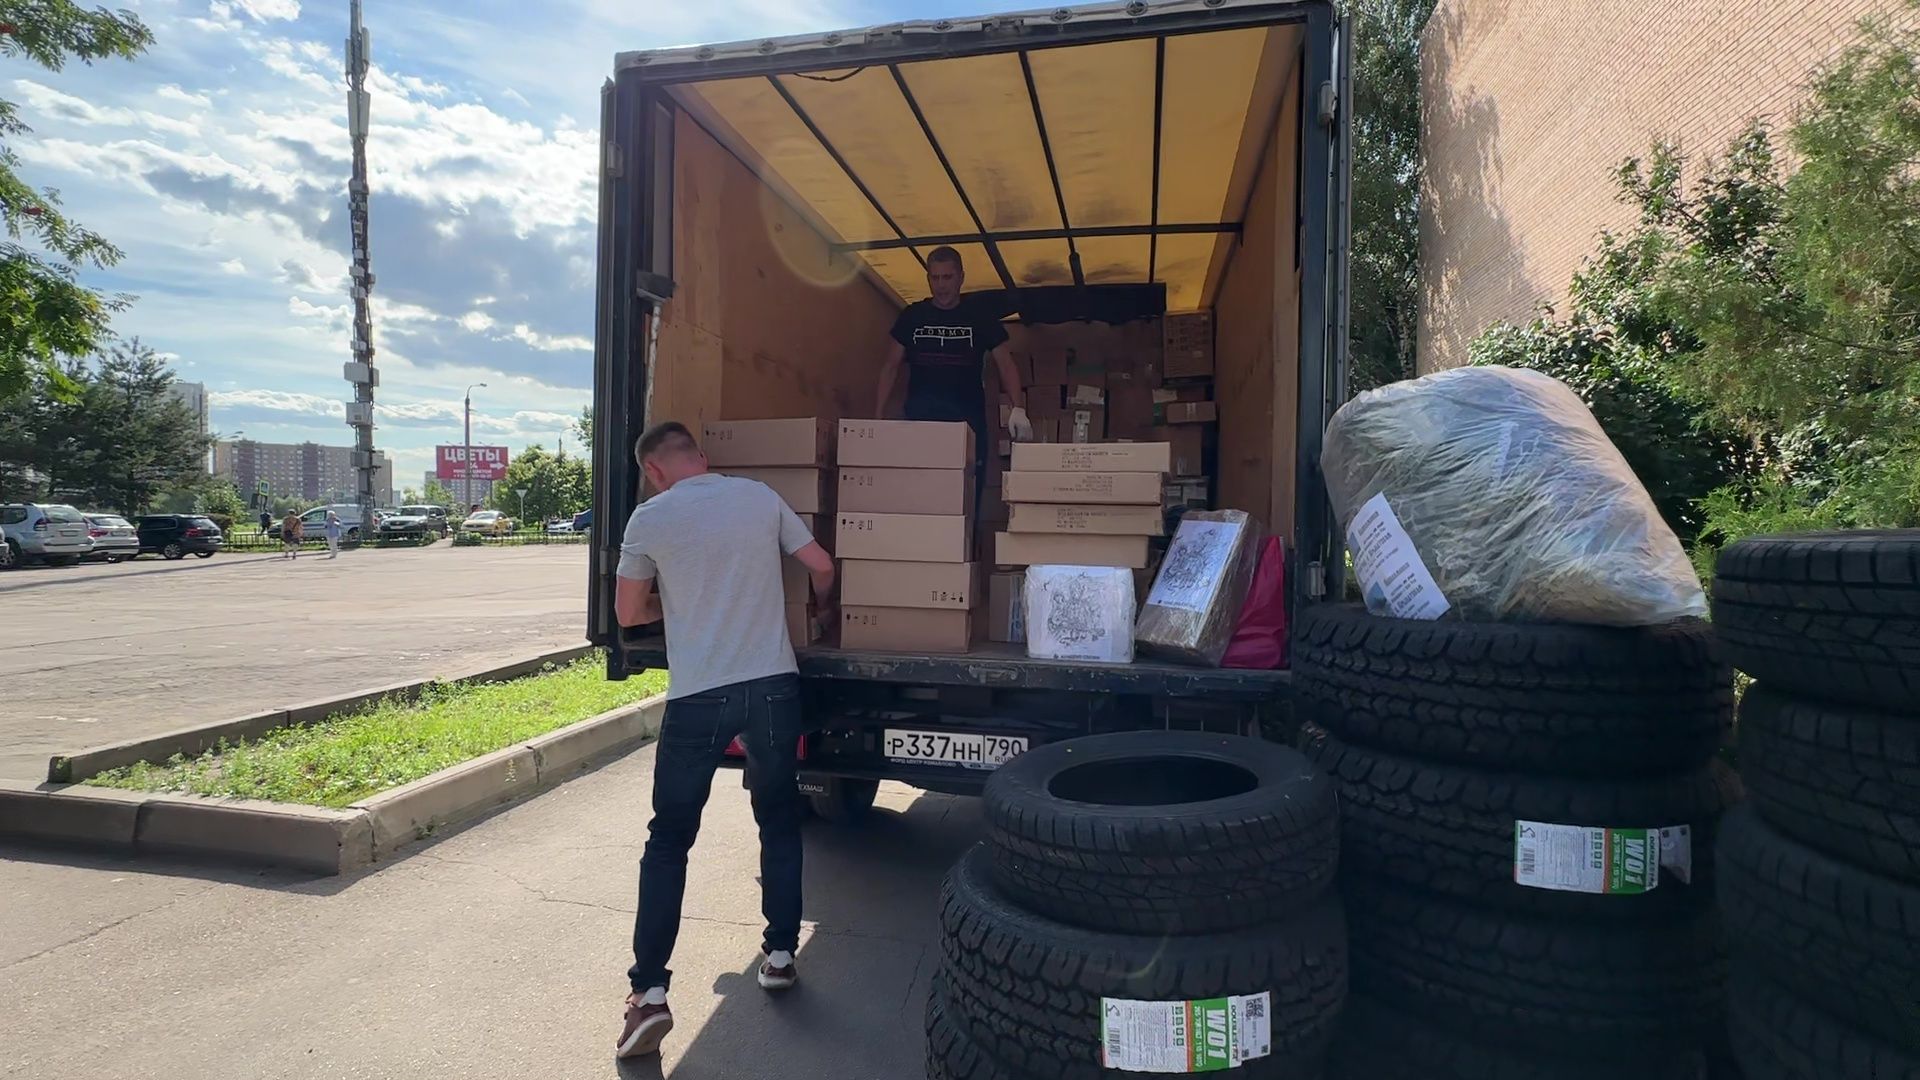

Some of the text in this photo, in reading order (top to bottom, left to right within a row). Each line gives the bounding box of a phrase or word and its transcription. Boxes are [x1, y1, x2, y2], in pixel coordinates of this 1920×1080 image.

[920, 329, 966, 337] TOMMY
[444, 448, 500, 463] ЦВЕТЫ
[986, 737, 1022, 756] 790
[1625, 838, 1645, 886] W01
[1206, 1009, 1227, 1059] W01
